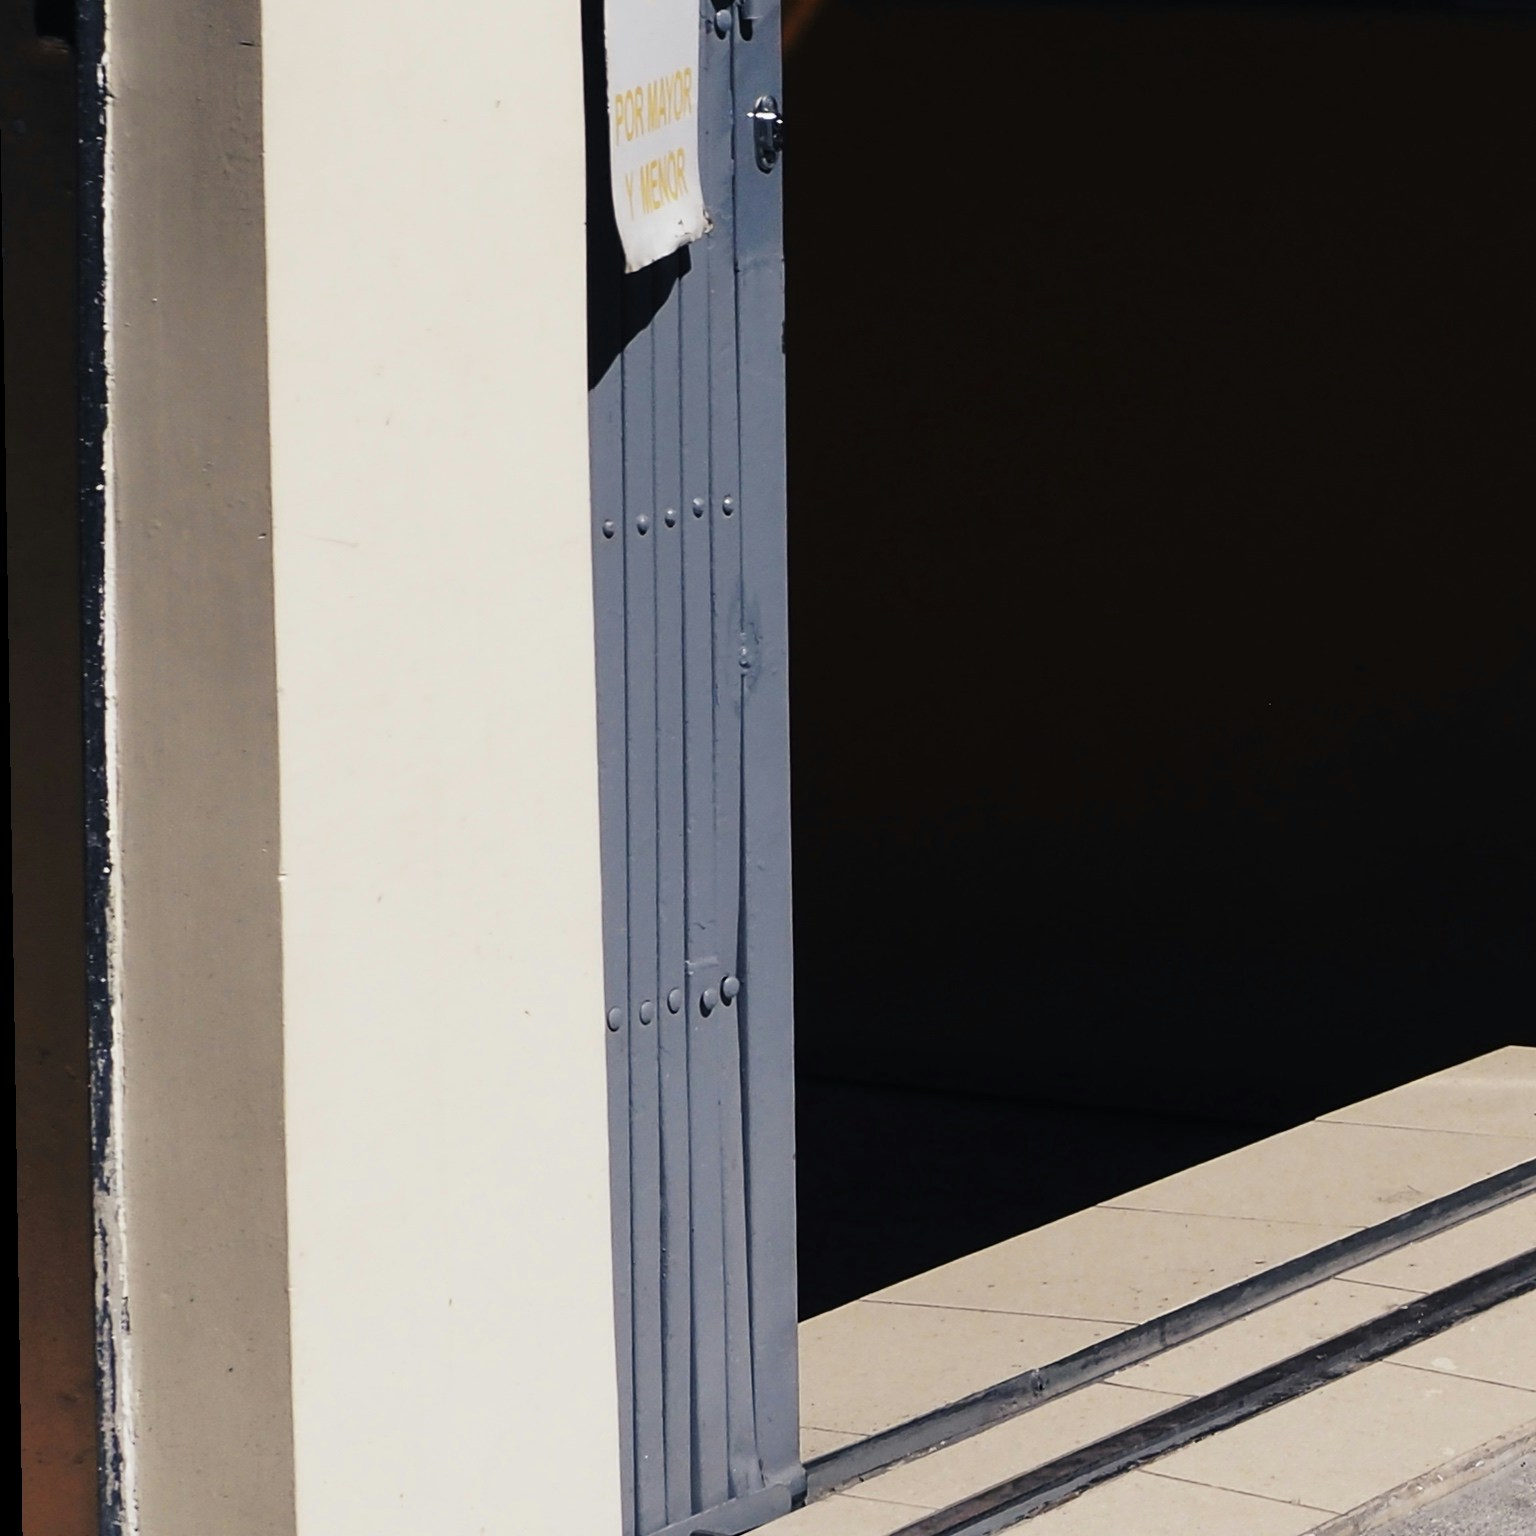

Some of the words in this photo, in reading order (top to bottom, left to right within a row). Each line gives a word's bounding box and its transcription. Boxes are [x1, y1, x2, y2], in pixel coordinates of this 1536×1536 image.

[614, 85, 645, 147] POR
[646, 66, 692, 132] MAYOR
[625, 169, 635, 221] Y
[639, 146, 689, 215] MENOR
